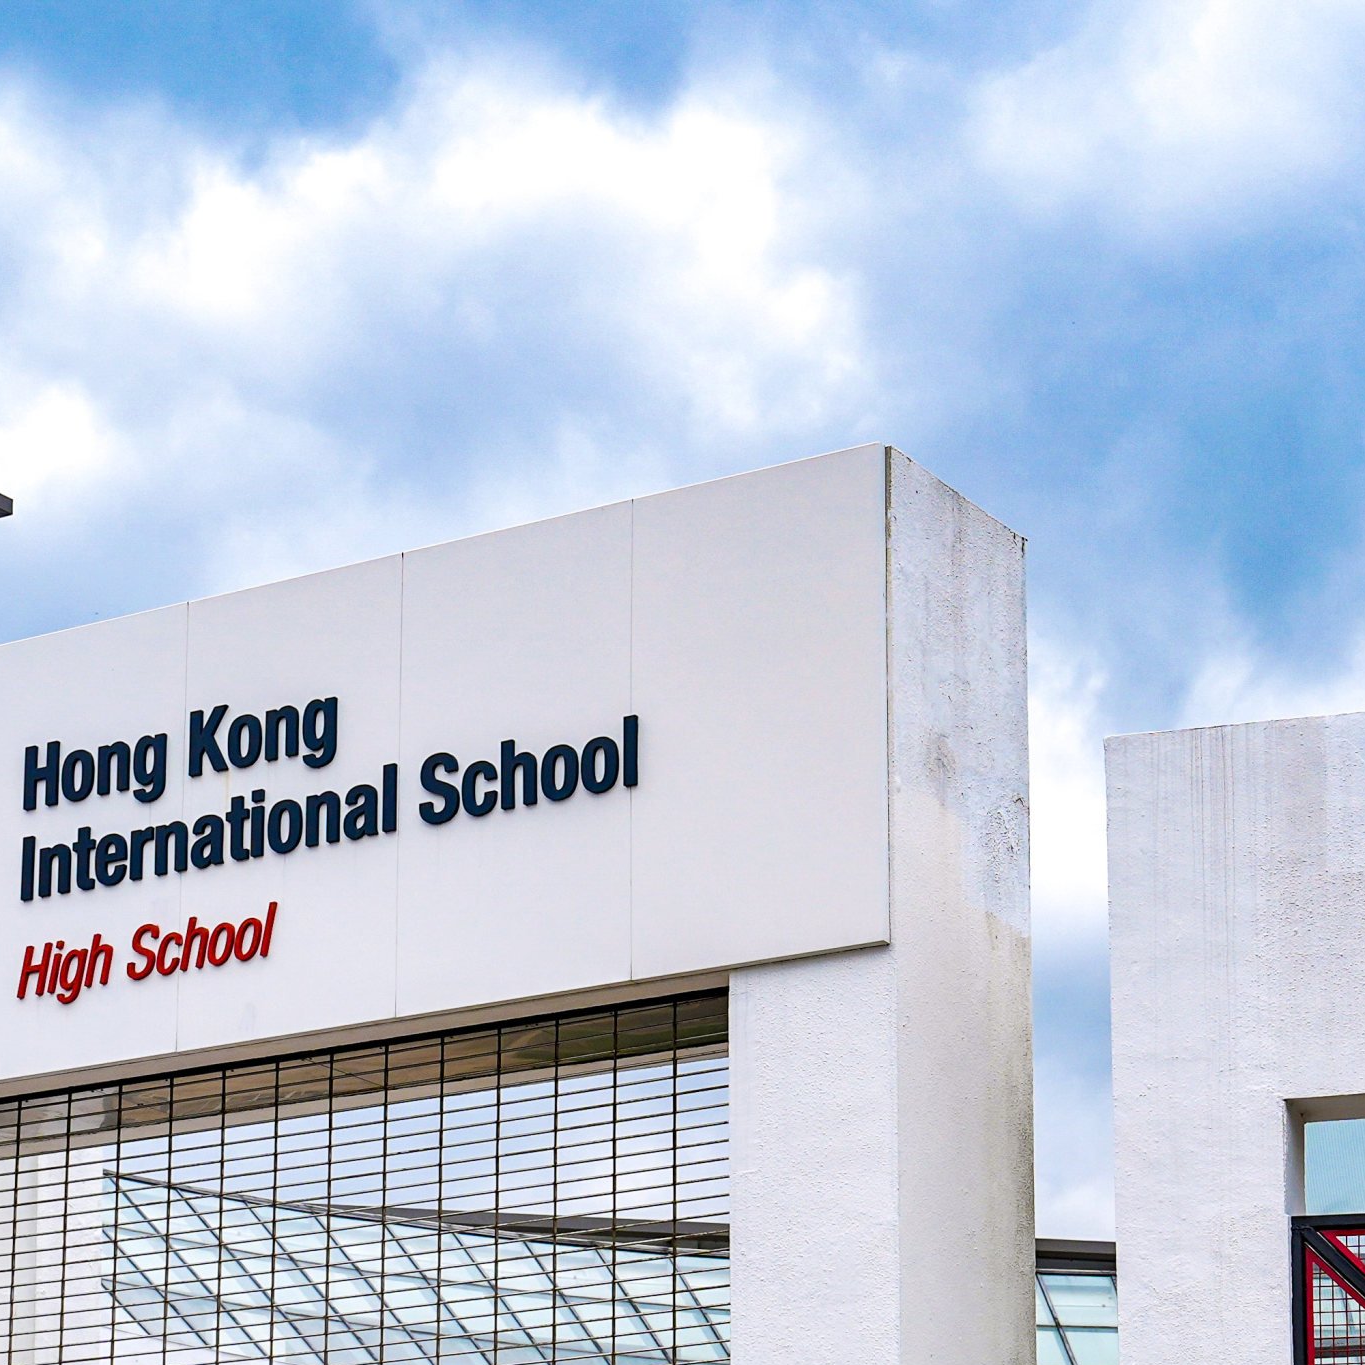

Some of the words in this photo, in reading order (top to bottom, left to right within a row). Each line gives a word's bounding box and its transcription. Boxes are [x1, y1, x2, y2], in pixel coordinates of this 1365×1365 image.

[20, 763, 399, 903] International
[418, 715, 639, 827] School
[23, 733, 169, 812] Hong
[188, 697, 339, 779] Kong
[17, 933, 114, 1006] High
[126, 902, 278, 981] School
